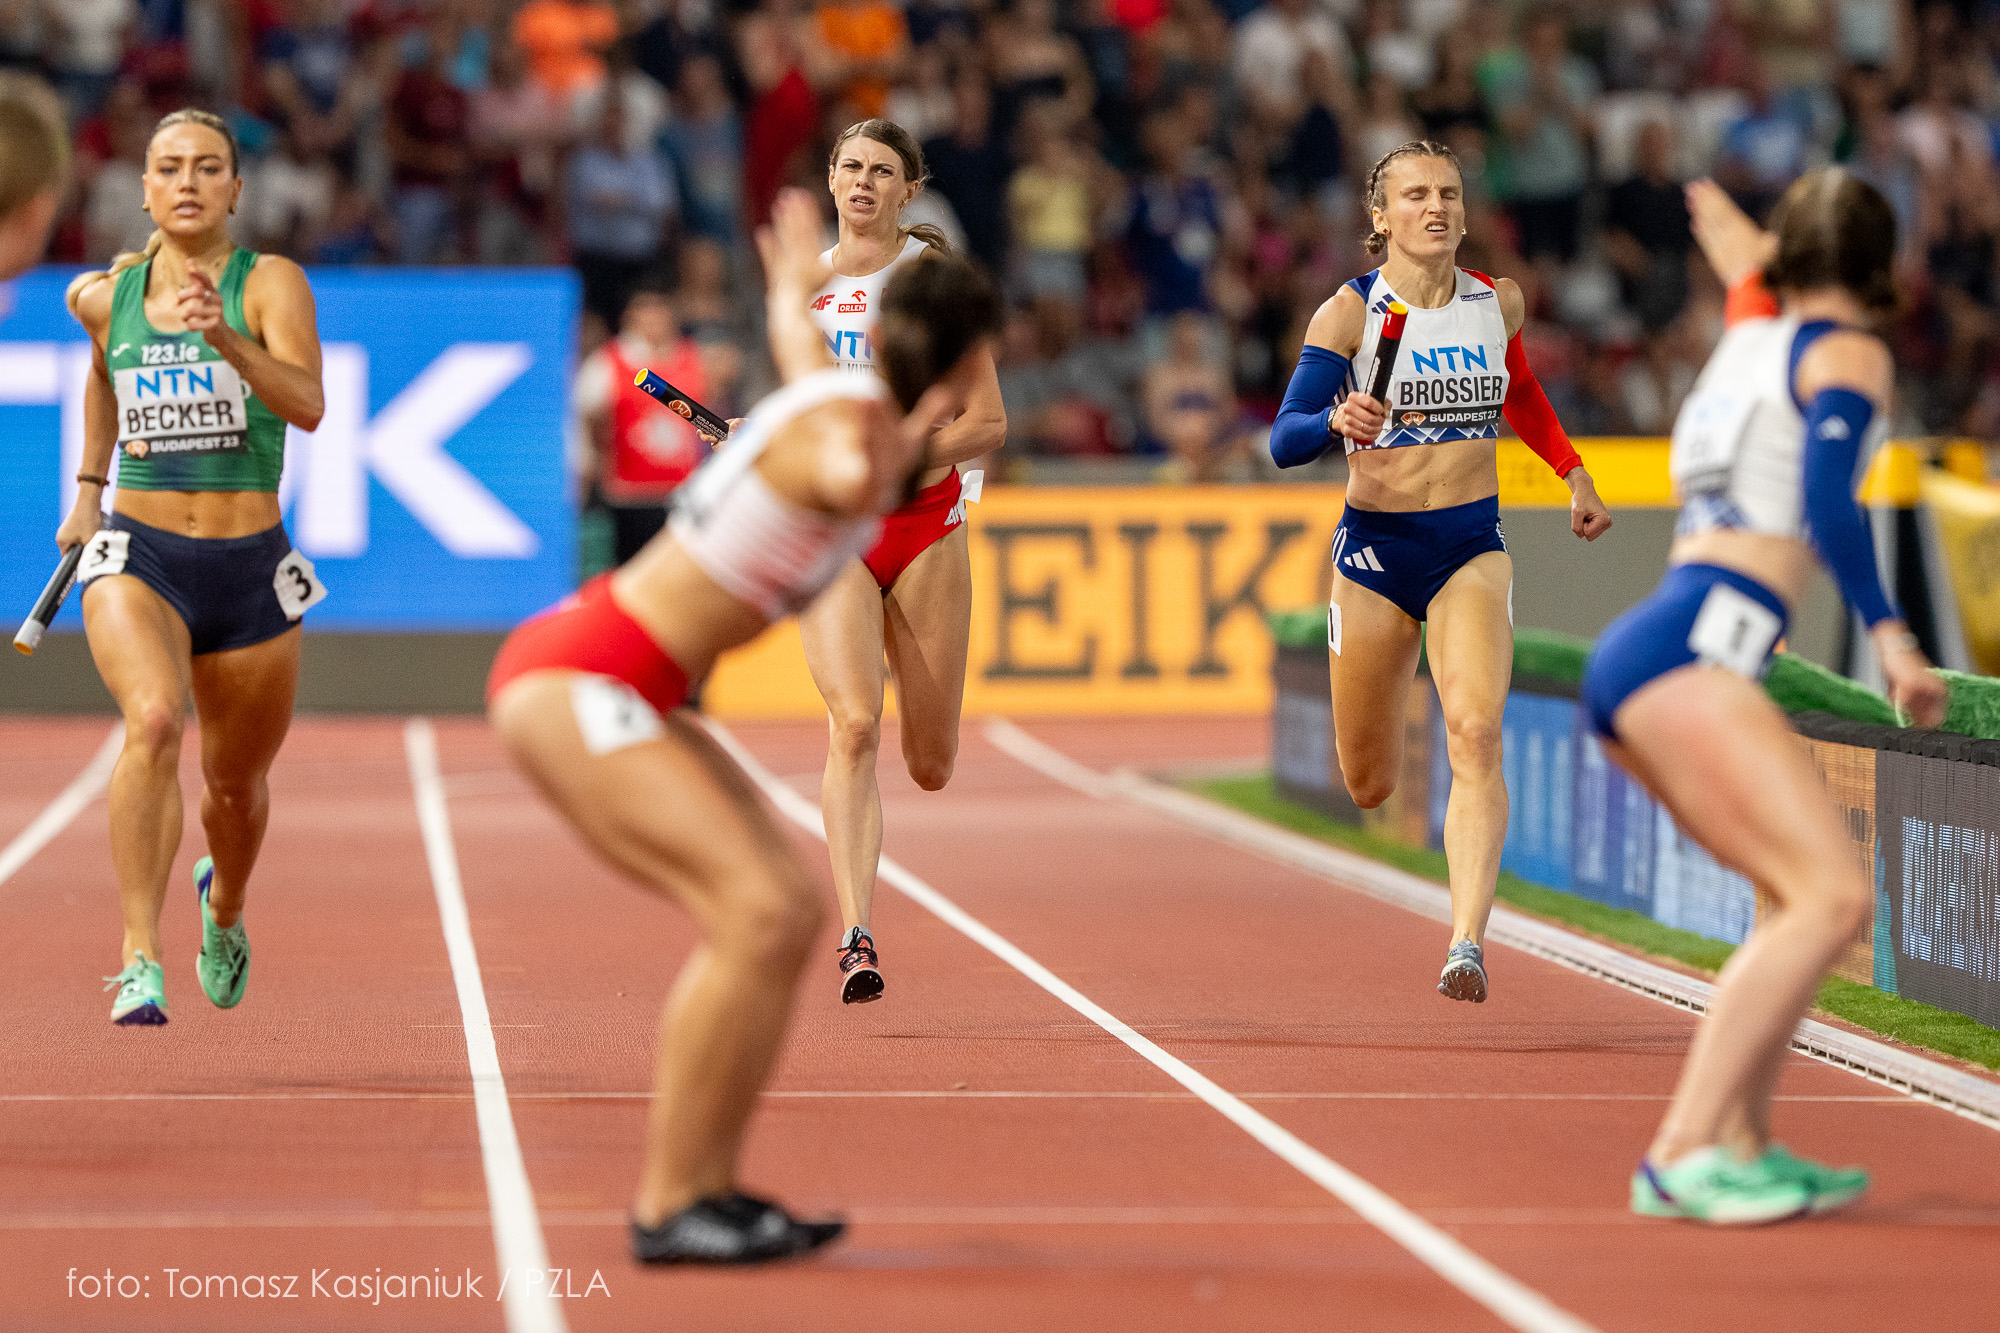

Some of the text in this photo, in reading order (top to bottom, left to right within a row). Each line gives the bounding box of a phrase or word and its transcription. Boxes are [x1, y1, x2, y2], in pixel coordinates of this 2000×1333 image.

[839, 304, 865, 312] ORLEN
[1386, 313, 1392, 326] 1
[141, 343, 199, 364] 123.ie
[1411, 345, 1488, 375] NTN
[136, 367, 213, 399] NTN
[643, 383, 656, 394] 2
[1400, 375, 1503, 406] BROSSIER
[127, 400, 233, 433] BECKER
[1429, 410, 1497, 422] BUDAPEST 23
[151, 435, 239, 453] BUDAPEST 23
[91, 540, 109, 567] 3
[287, 565, 312, 602] 3
[984, 522, 1331, 679] EIK
